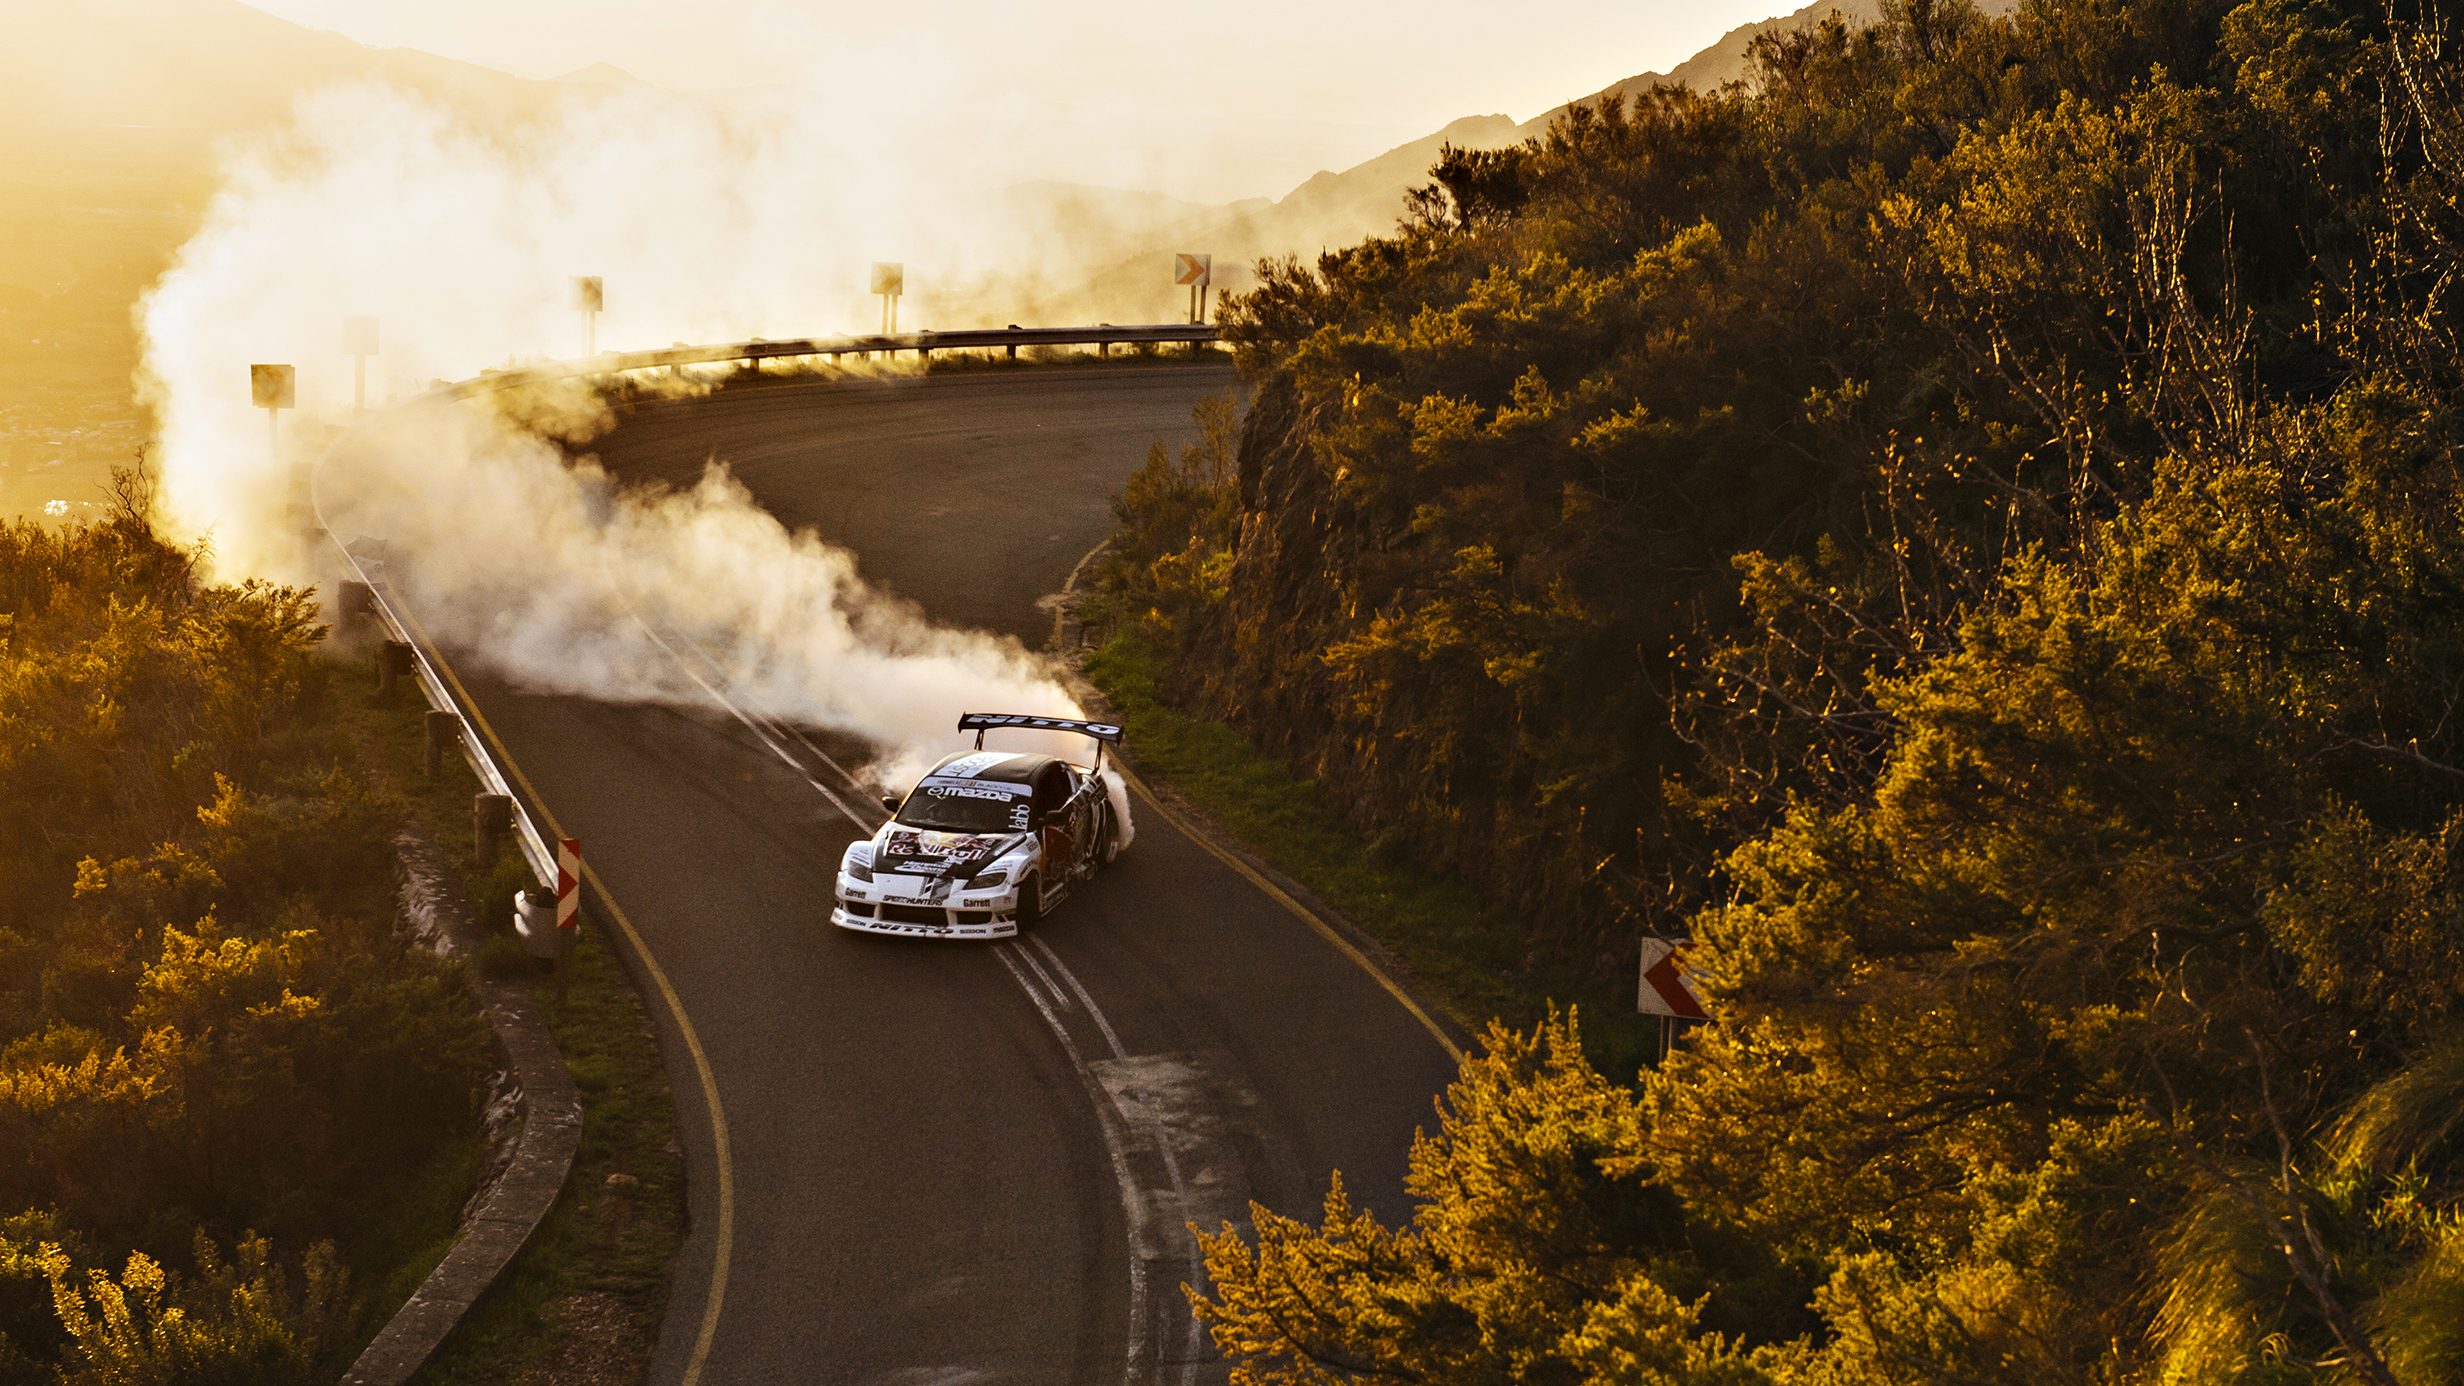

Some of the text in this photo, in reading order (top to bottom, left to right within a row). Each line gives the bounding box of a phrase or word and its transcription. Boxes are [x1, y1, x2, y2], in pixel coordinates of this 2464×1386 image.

[966, 714, 1120, 735] NITTO
[845, 887, 867, 900] Garrett
[883, 894, 943, 906] SPEEDHUNTERS
[963, 898, 991, 907] Garrett
[869, 922, 954, 934] NITTO
